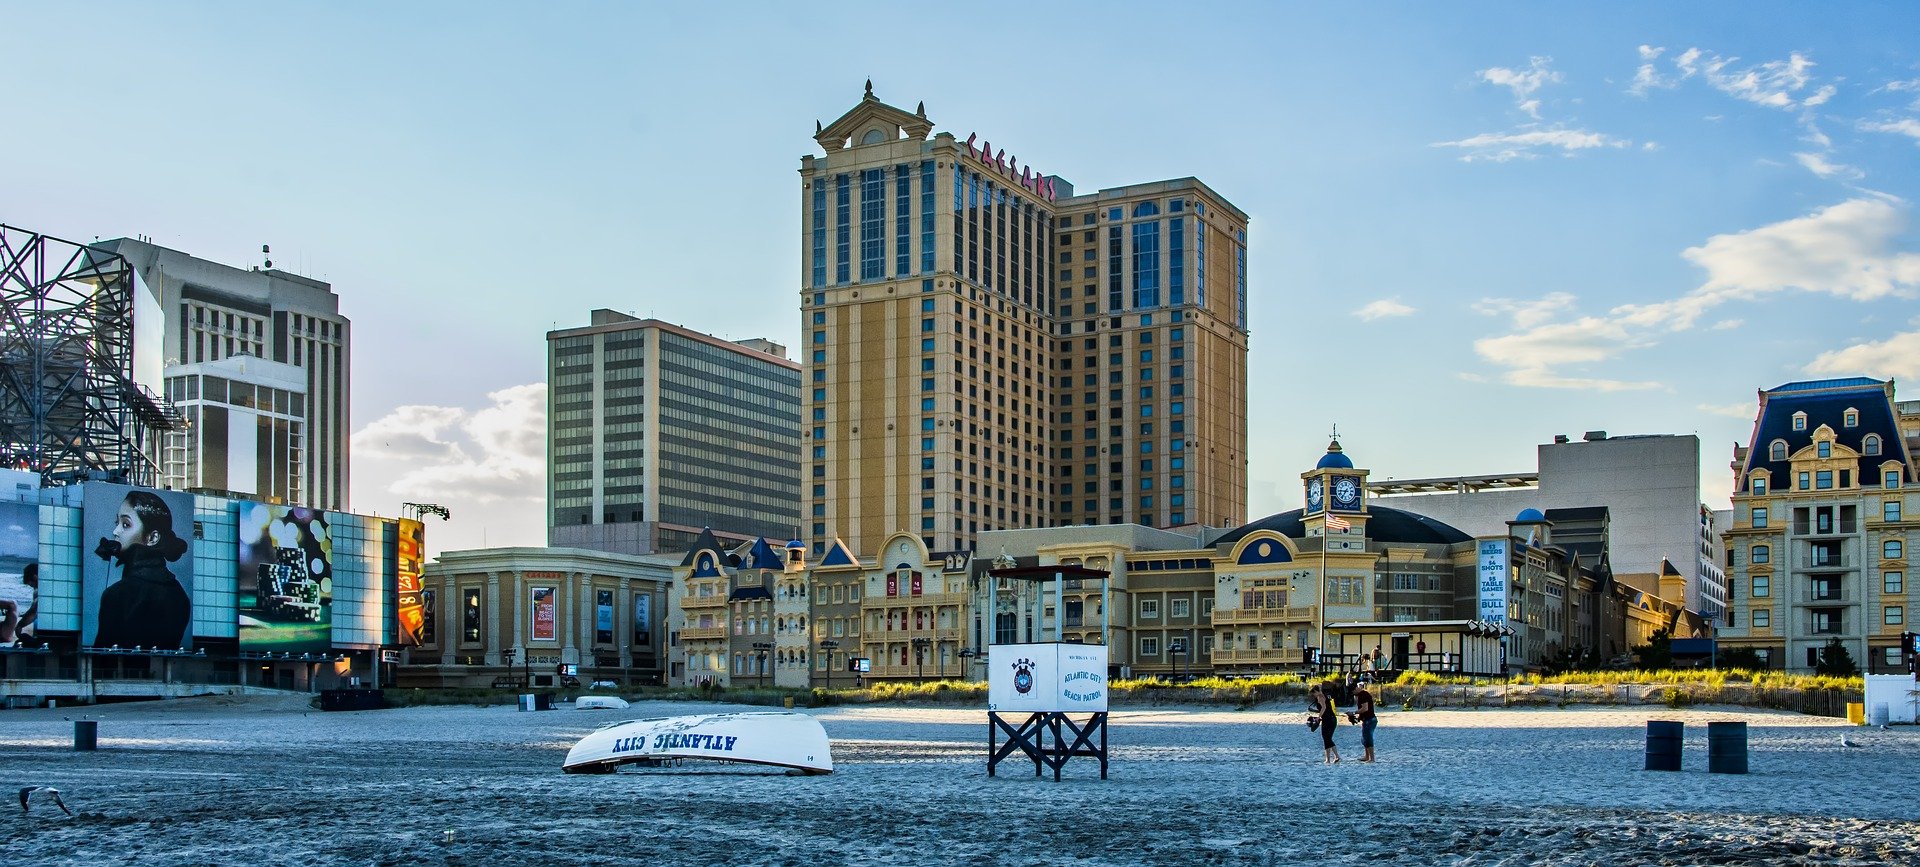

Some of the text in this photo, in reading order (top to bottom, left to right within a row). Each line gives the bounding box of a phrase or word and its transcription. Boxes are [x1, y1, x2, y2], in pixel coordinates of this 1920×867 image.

[967, 132, 1056, 202] CAESARS
[399, 576, 413, 590] 23
[399, 596, 416, 605] 8
[1482, 614, 1504, 622] LIVE
[1064, 670, 1102, 684] ATLANTIC CITY
[1063, 689, 1102, 702] BEACH PATROL
[612, 733, 738, 753] ATLANTIC CITY
